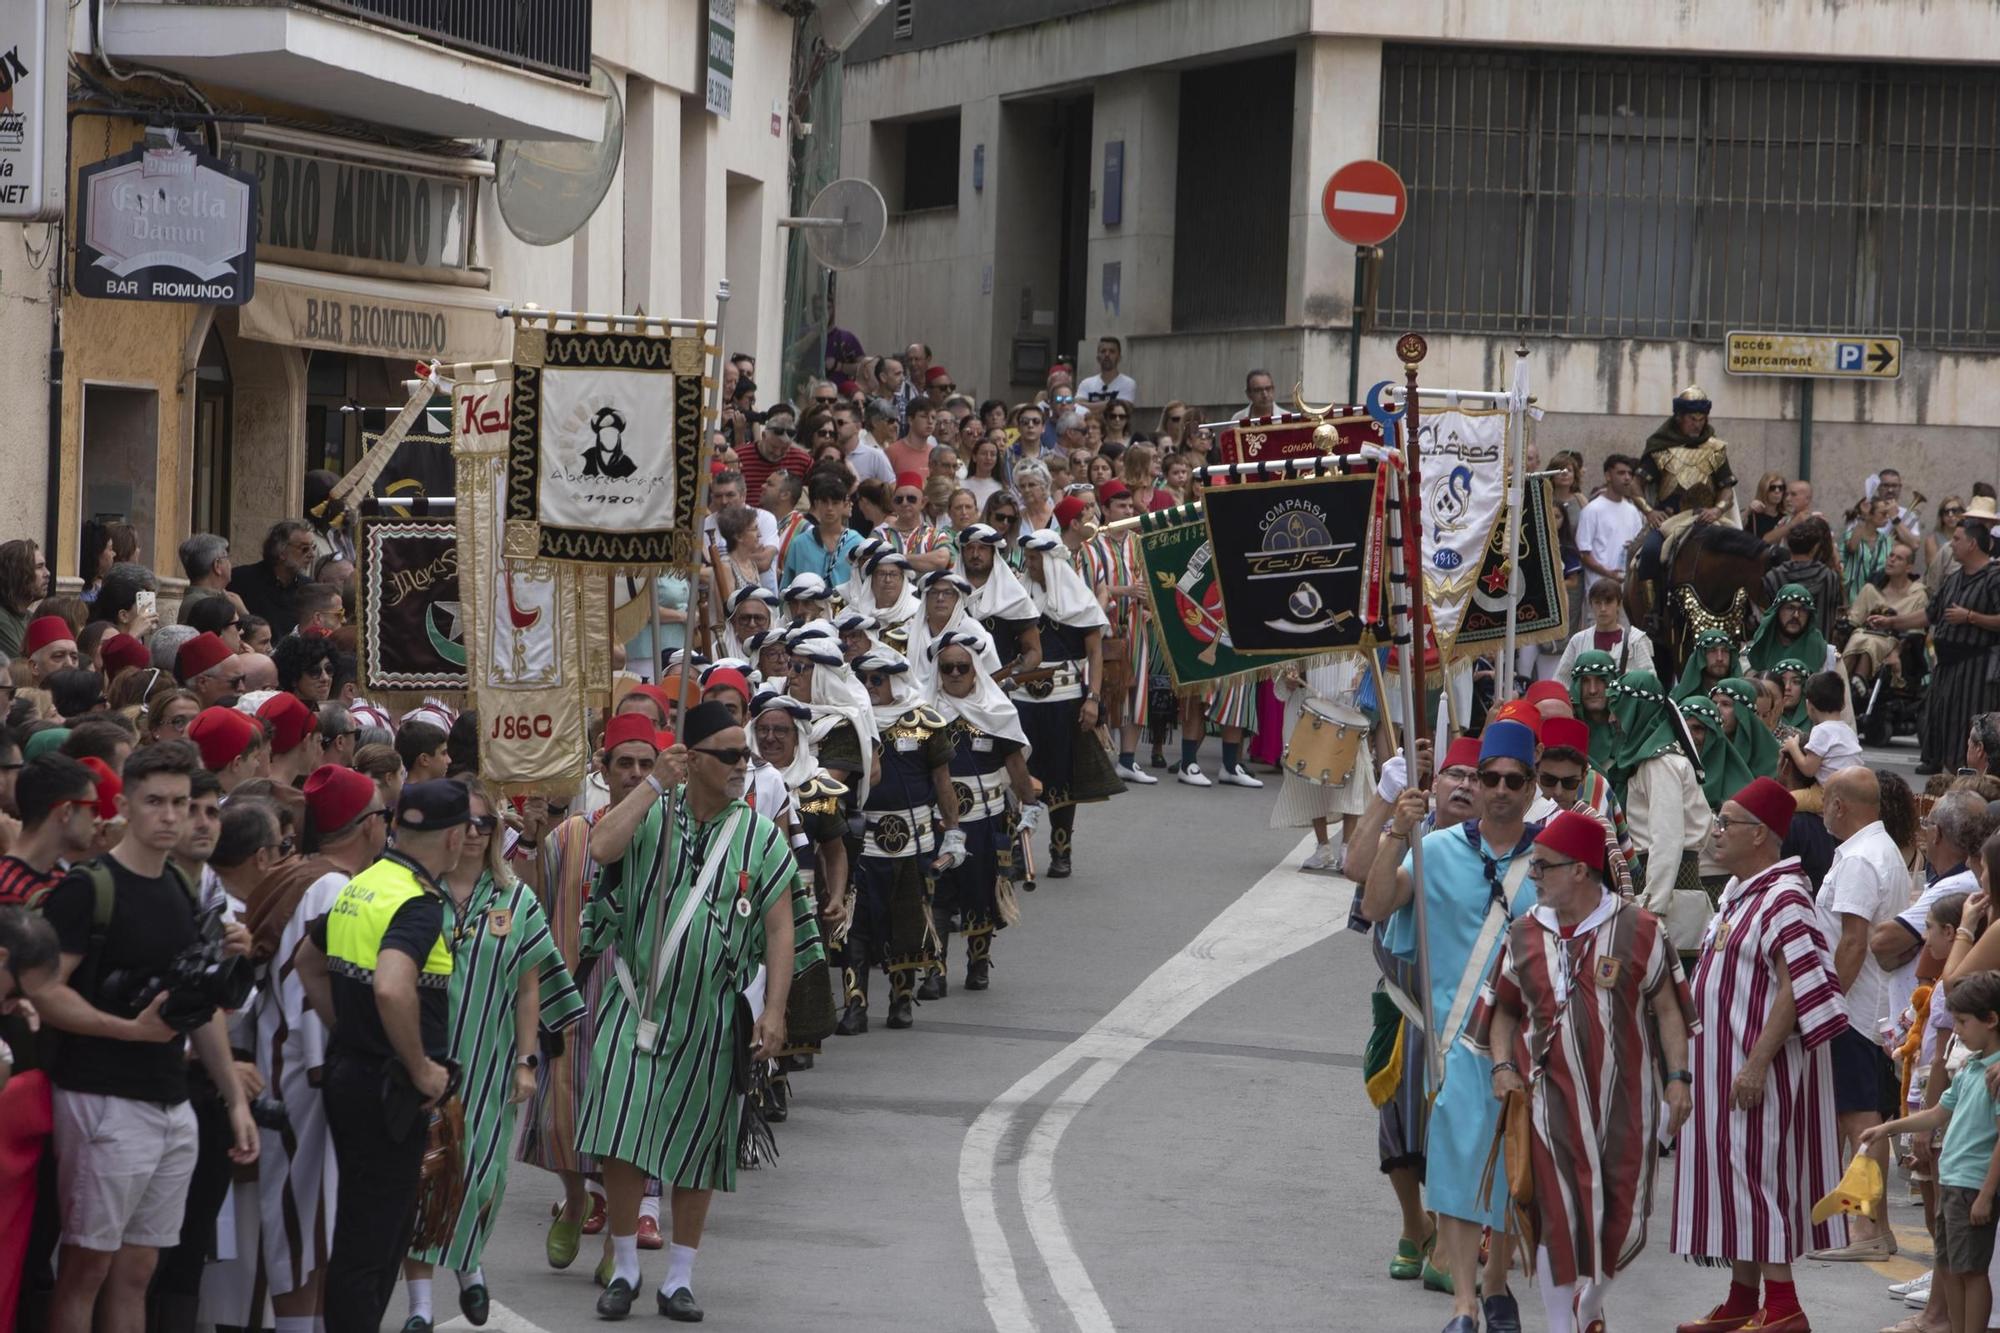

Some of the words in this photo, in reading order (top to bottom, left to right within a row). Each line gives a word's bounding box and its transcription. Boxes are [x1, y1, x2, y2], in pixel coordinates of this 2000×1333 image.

[111, 182, 227, 219] Estrella
[269, 156, 321, 250] RIO
[331, 164, 430, 266] MUNDO
[132, 216, 206, 244] Damm
[106, 280, 139, 294] BAR
[152, 282, 234, 299] RIOMUNDO
[306, 298, 343, 344] BAR
[349, 304, 447, 353] RIOMUNDO
[1733, 356, 1813, 367] aparcament
[1841, 346, 1859, 369] P
[584, 493, 635, 504] 1980
[1259, 498, 1327, 532] COMPARSA
[1433, 551, 1460, 566] 1918
[491, 713, 553, 740] 1860
